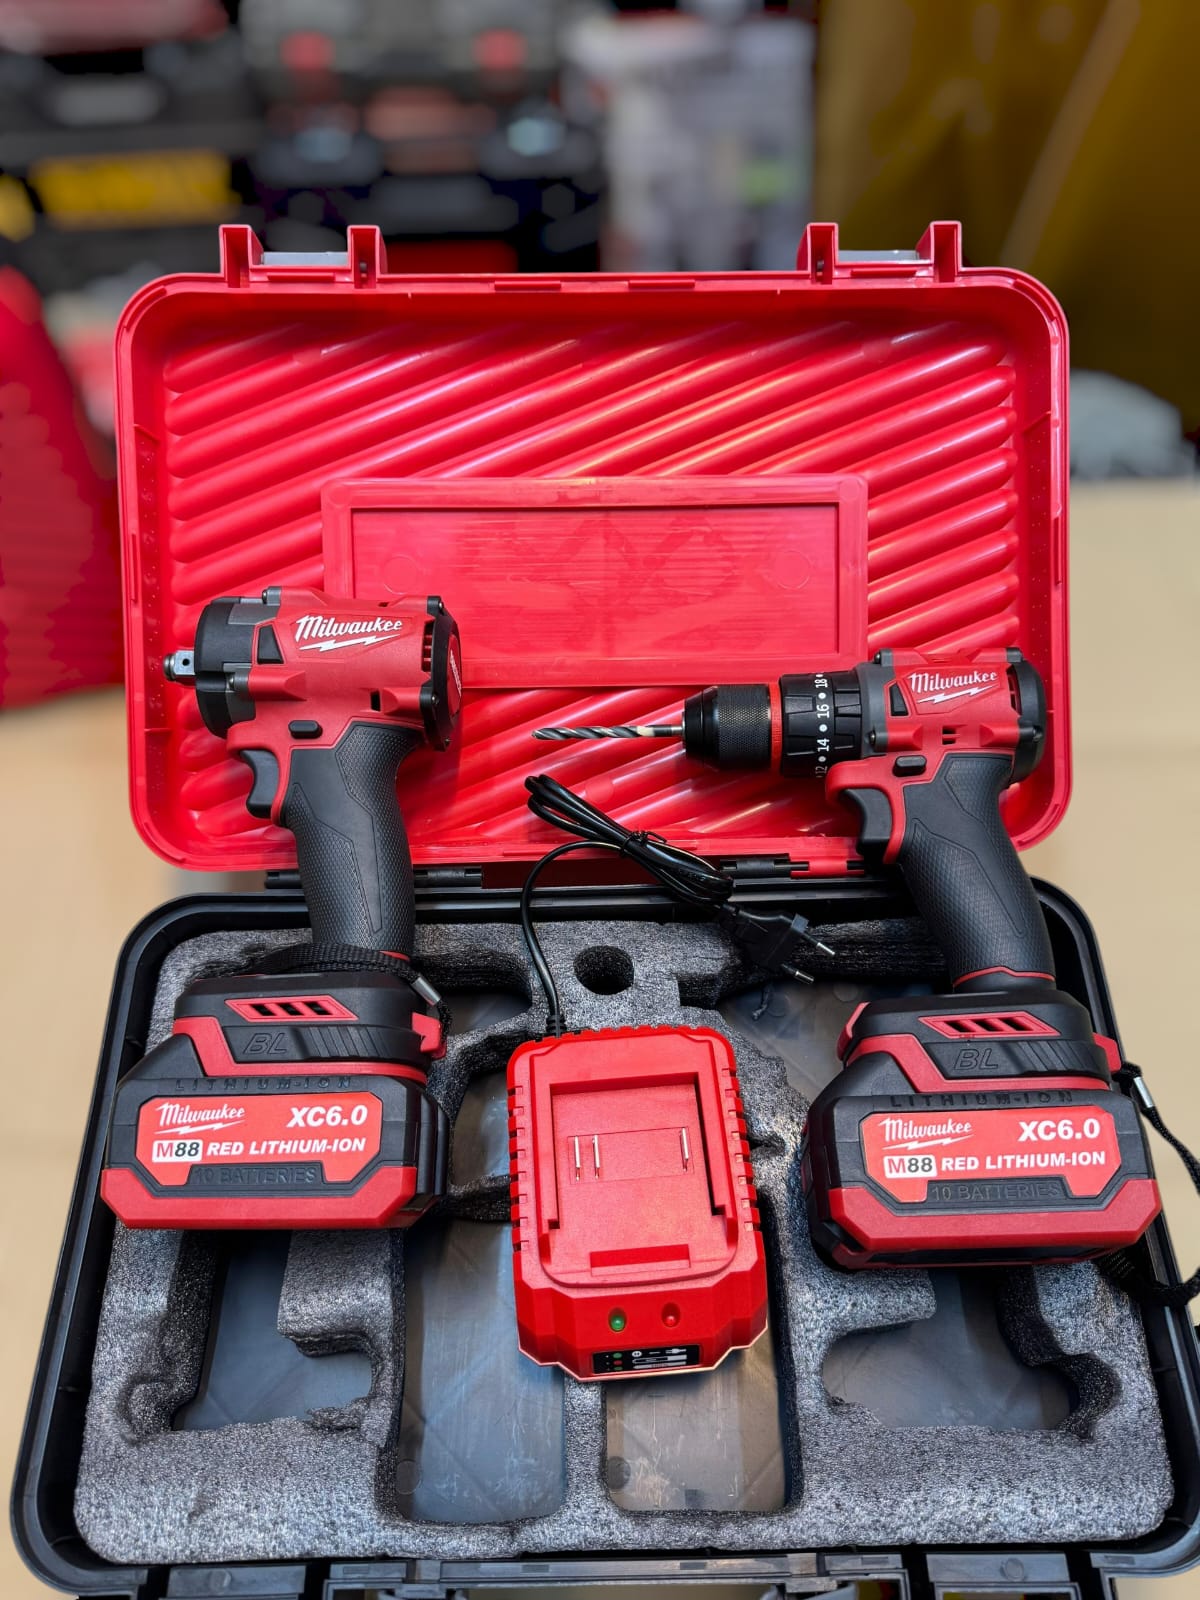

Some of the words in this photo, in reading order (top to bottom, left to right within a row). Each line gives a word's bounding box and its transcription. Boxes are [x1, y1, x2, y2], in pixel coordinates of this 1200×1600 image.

[294, 615, 403, 642] Milwaukee
[814, 678, 828, 688] 18
[907, 671, 998, 694] Milwaukee
[816, 704, 830, 719] 16
[816, 738, 830, 752] 14
[244, 1033, 289, 1055] BL
[954, 1048, 1000, 1071] BL
[154, 1102, 245, 1127] Milwaukee
[287, 1105, 368, 1128] XC6.0
[877, 1118, 973, 1144] Milwaukee
[1018, 1119, 1101, 1142] XC6.0
[156, 1141, 200, 1159] M88
[206, 1142, 245, 1156] RED
[249, 1138, 366, 1155] LITHIUM-ION
[887, 1157, 934, 1175] M88
[940, 1156, 980, 1172] RED
[985, 1151, 1106, 1169] LITHIUM-ION
[219, 1166, 318, 1184] BATTERIES
[931, 1186, 952, 1201] 10
[958, 1181, 1061, 1201] BATTERIES
